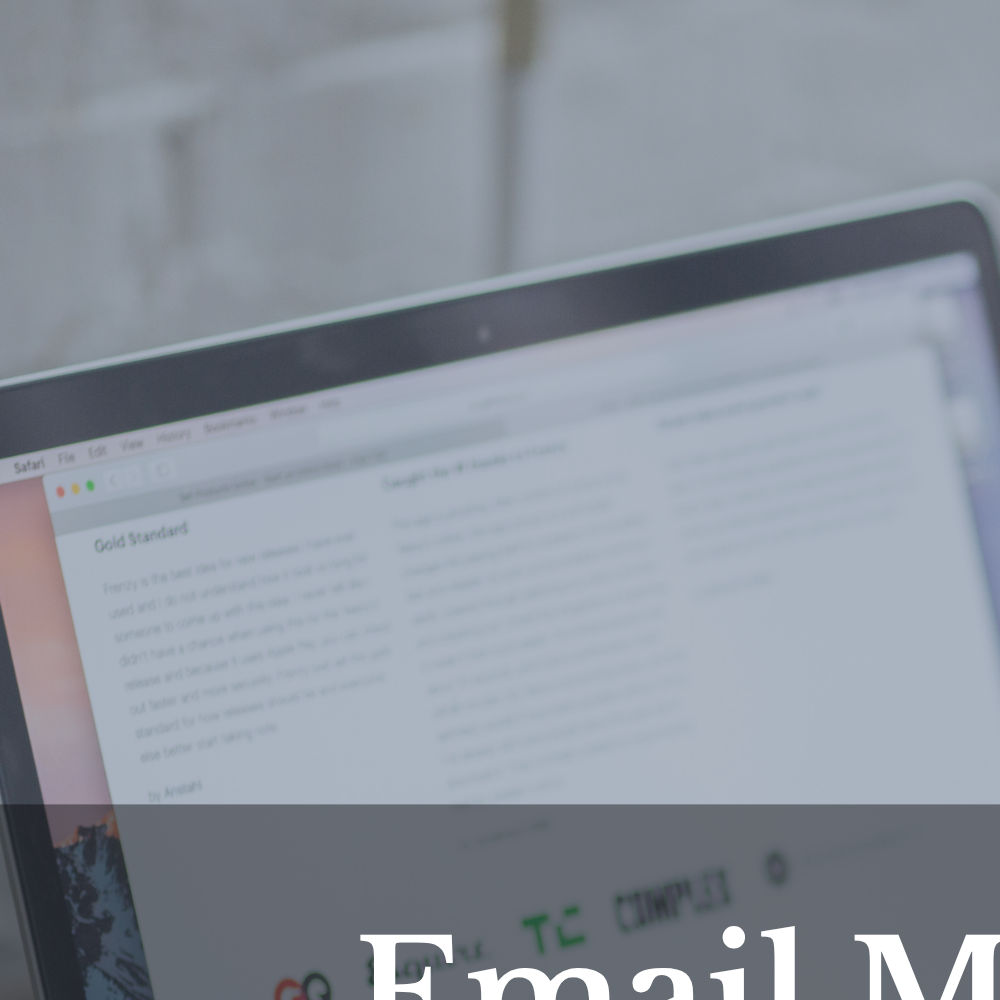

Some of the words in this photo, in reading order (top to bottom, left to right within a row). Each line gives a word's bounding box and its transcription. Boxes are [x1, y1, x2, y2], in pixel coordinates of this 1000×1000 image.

[14, 456, 46, 475] Safari
[57, 452, 77, 466] File
[87, 445, 109, 460] Edit
[119, 438, 145, 452] View
[156, 428, 192, 444] History
[94, 536, 126, 553] Gold
[127, 520, 190, 546] Standard
